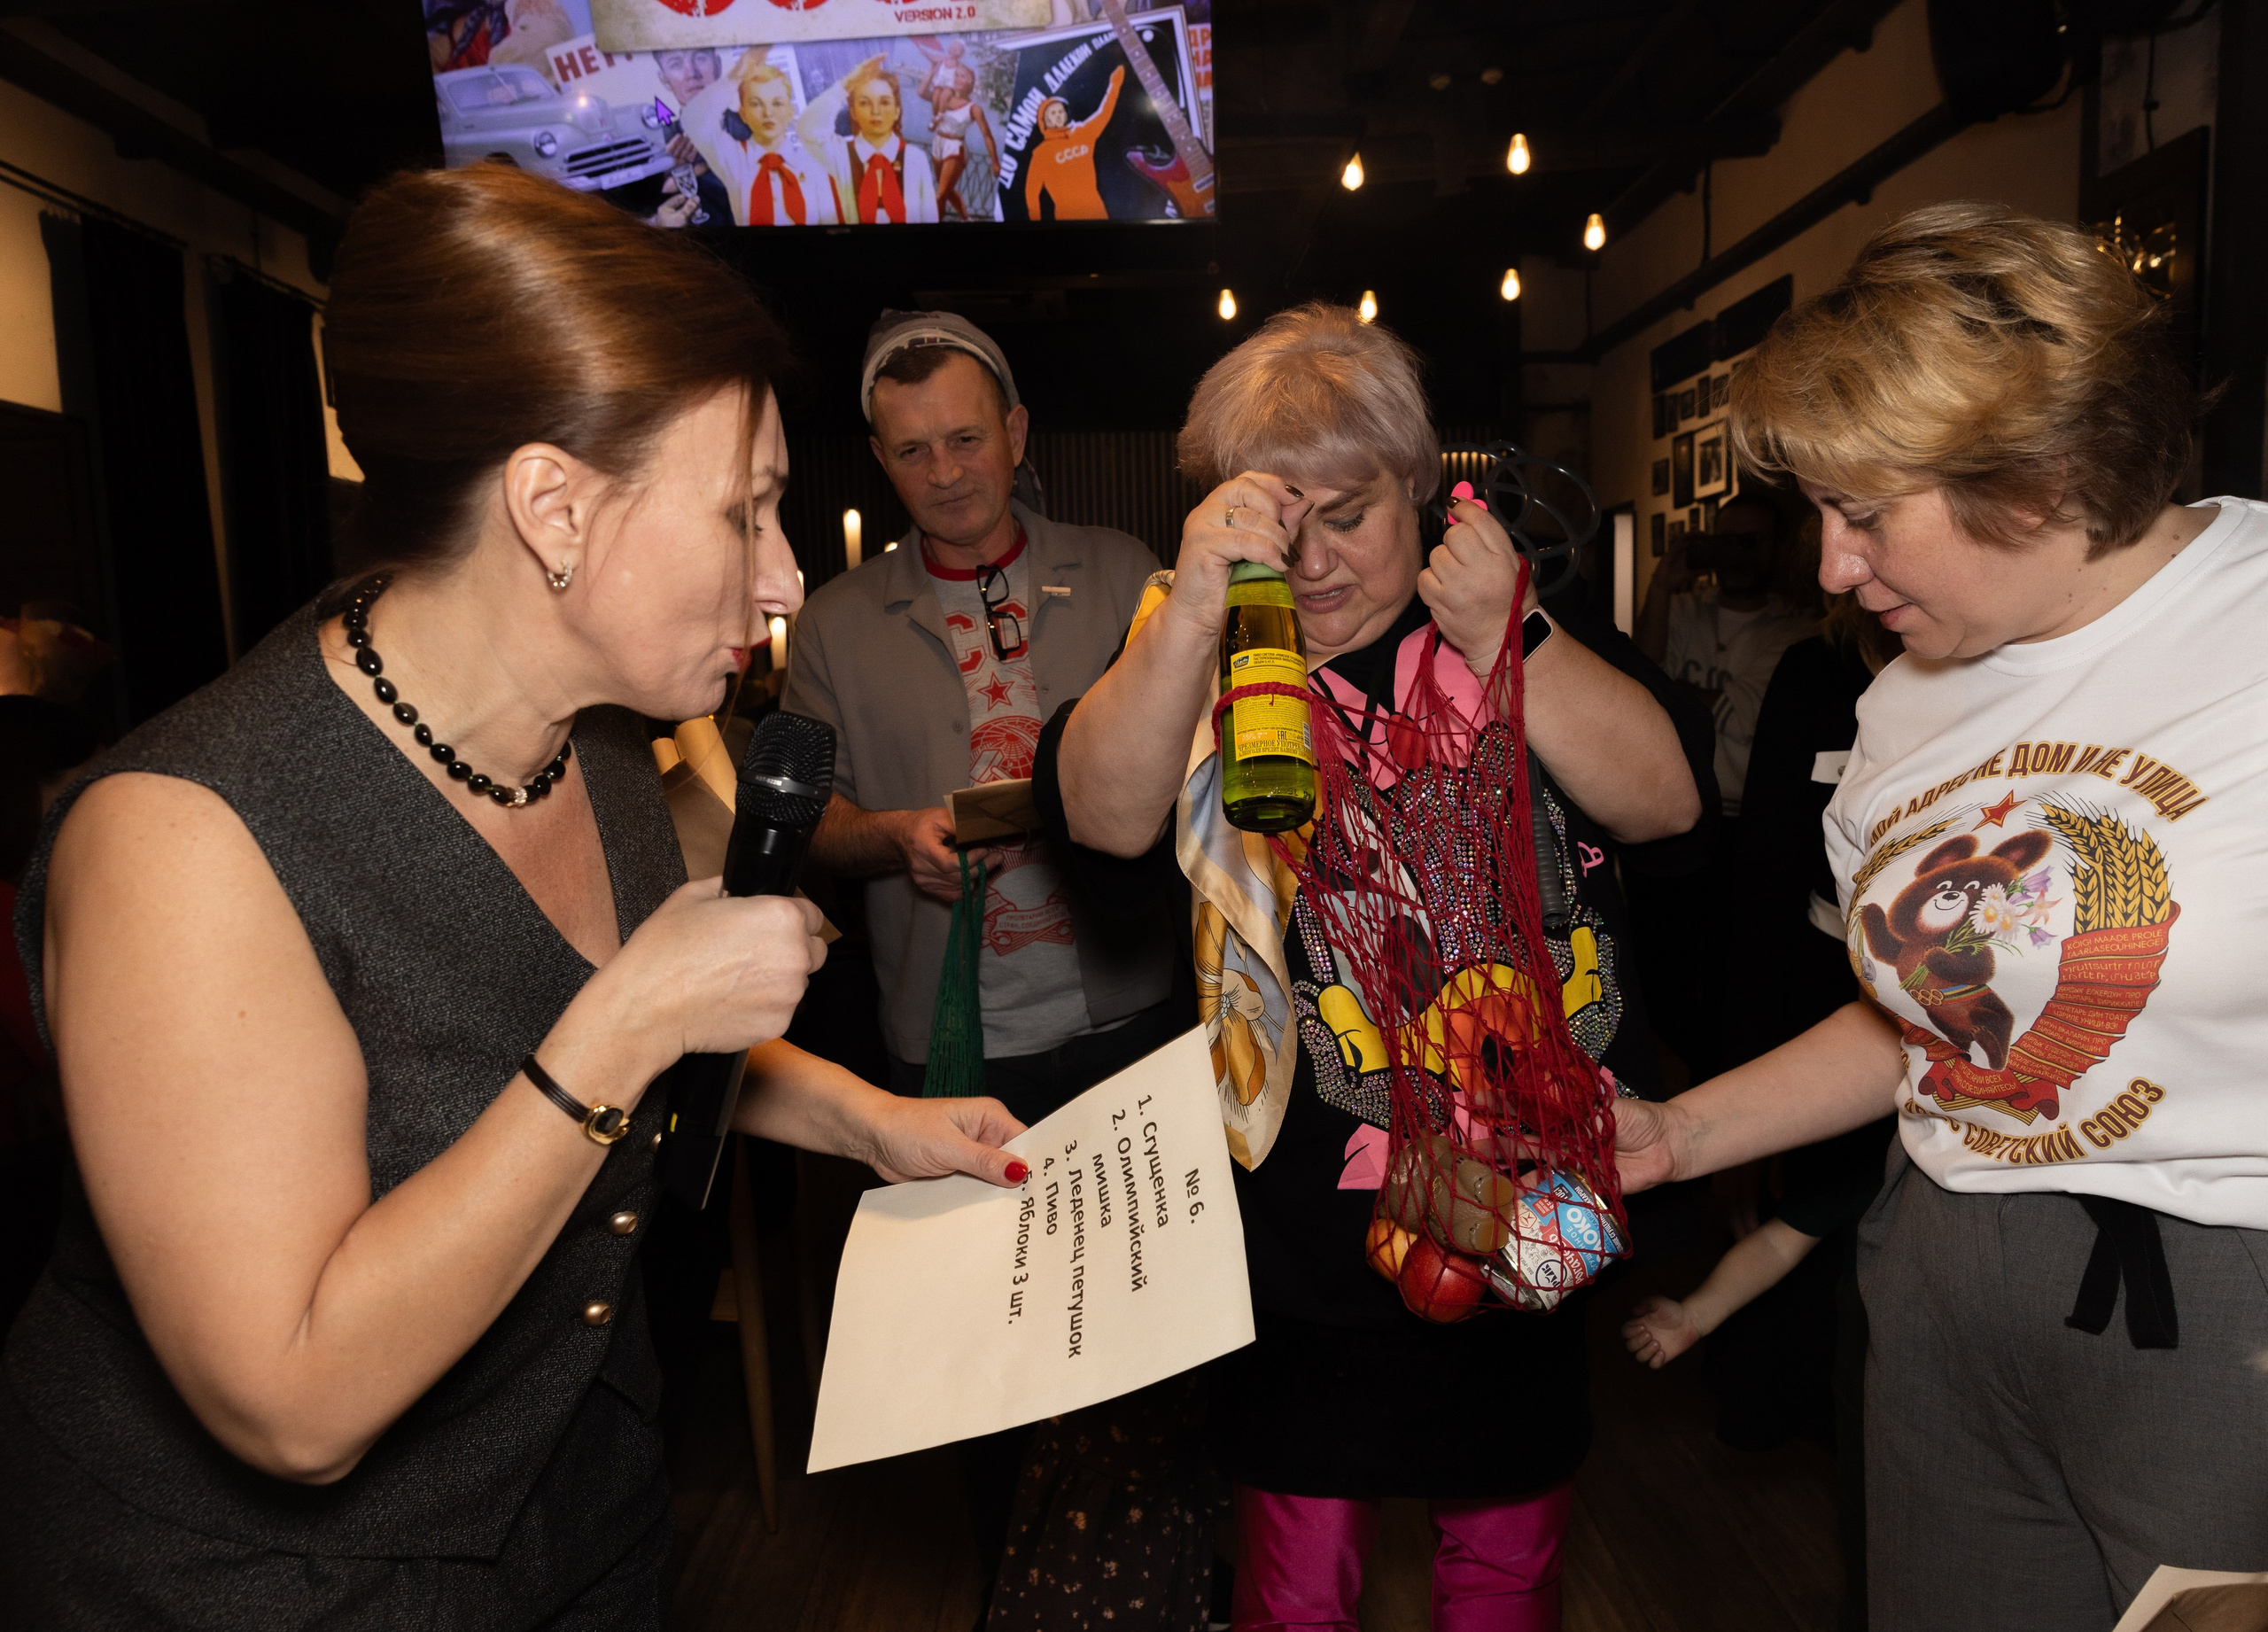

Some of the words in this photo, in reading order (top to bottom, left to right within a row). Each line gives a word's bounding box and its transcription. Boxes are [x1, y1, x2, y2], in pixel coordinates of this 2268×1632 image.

[895, 8, 952, 23] VERSION
[956, 6, 976, 19] 2.0
[1055, 144, 1089, 164] СССР
[1970, 746, 2008, 781] НЕ
[2007, 741, 2078, 779] ДОМ
[2070, 744, 2103, 774] И
[2087, 748, 2132, 781] НЕ
[2118, 752, 2210, 823] УЛИЦА
[2094, 932, 2129, 944] MAADE
[2132, 929, 2167, 940] PROLE-
[2087, 1007, 2105, 1018] ДИН
[2105, 1011, 2129, 1022] ТОАТЕ
[1984, 1073, 2003, 1084] ВСЕХ
[1138, 1094, 1153, 1115] 1.
[1112, 1109, 1126, 1131] 2.
[1962, 1121, 2088, 1166] СОВЕТСКИЙ
[2078, 1076, 2166, 1150] СОЮЗ
[1065, 1139, 1077, 1162] 3.
[1042, 1156, 1054, 1177] 4.
[1143, 1122, 1169, 1228] Сгущенка
[1091, 1153, 1112, 1229] мишка
[1185, 1168, 1200, 1197] №
[1045, 1181, 1060, 1236] Пиво
[1068, 1169, 1084, 1264] Леденец
[1117, 1137, 1147, 1293] Олимпийский
[1189, 1202, 1204, 1224] 6.
[1014, 1196, 1035, 1270] Яблоки
[1013, 1273, 1029, 1286] 3
[1008, 1290, 1024, 1325] шт.
[1068, 1267, 1084, 1359] петушок
